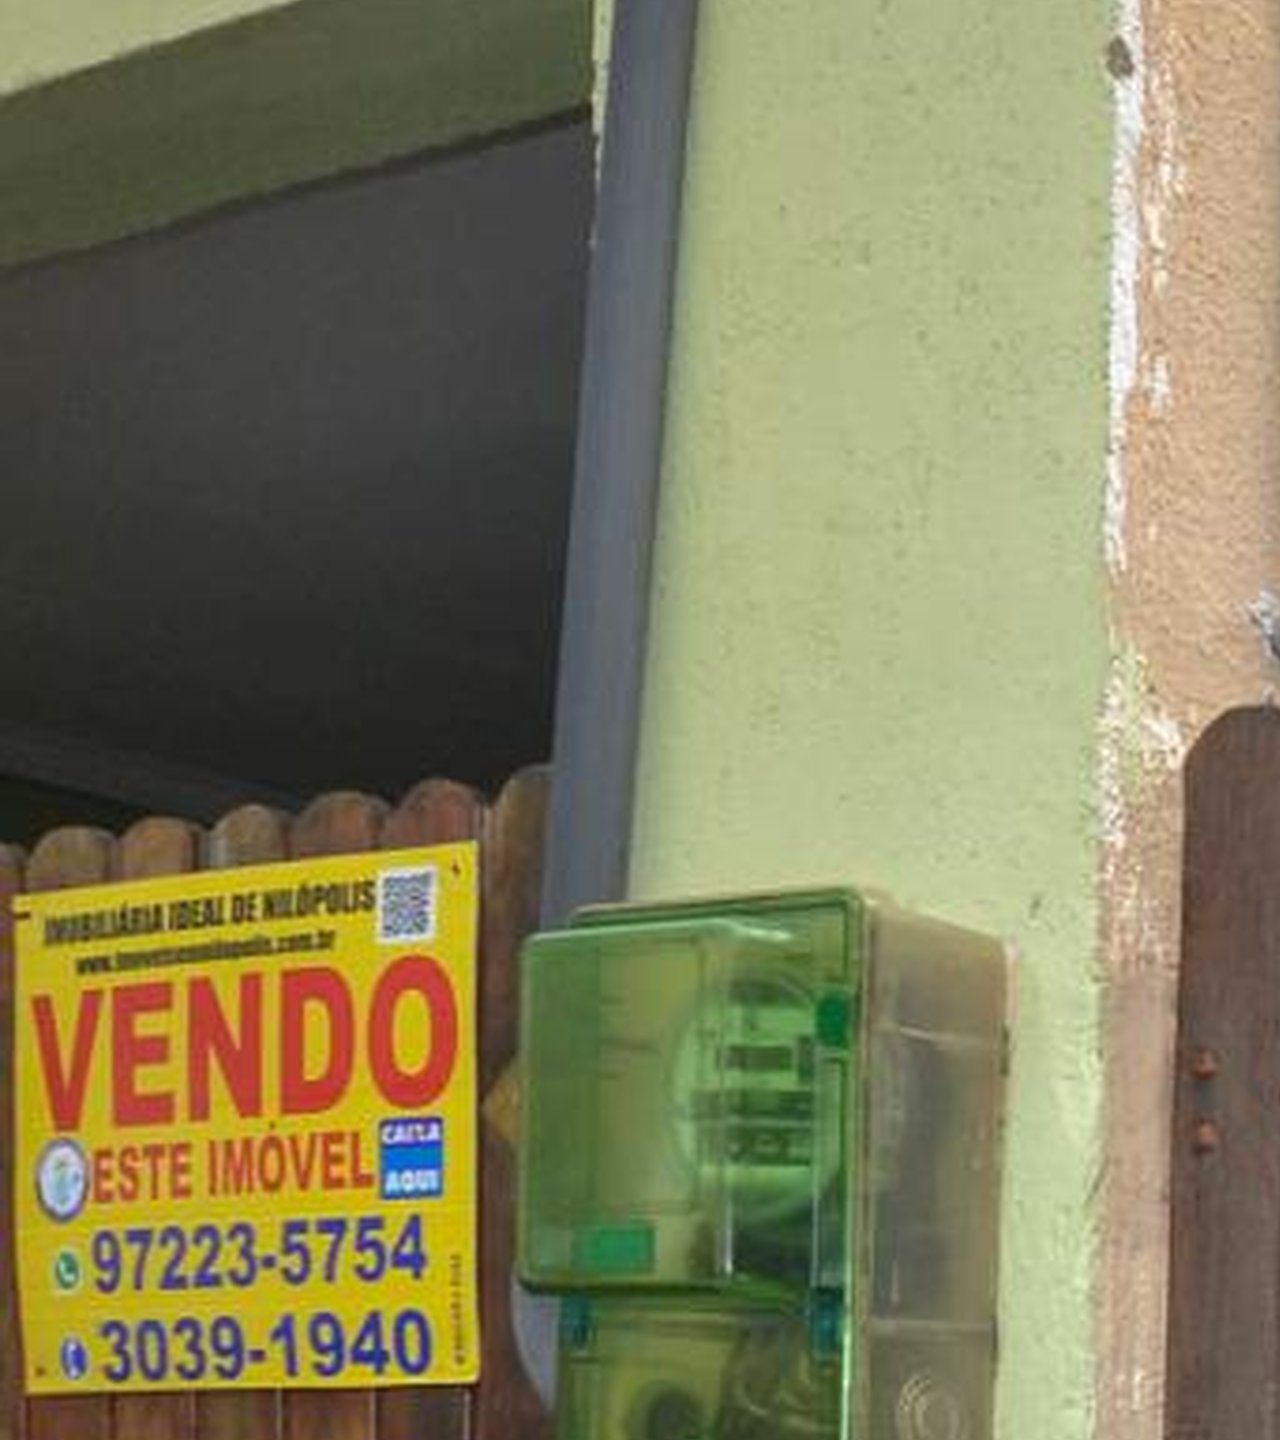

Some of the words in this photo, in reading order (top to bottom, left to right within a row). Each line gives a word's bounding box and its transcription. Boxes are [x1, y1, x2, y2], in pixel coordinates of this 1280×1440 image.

[168, 894, 226, 932] IDEAL
[231, 891, 259, 925] DE
[31, 954, 458, 1132] VENDO
[92, 1142, 193, 1205] ESTE
[208, 1128, 375, 1197] IMÓVEL
[381, 1121, 440, 1145] CAIXA
[91, 1214, 428, 1295] 97223-5754
[98, 1308, 434, 1383] 3039-1940
